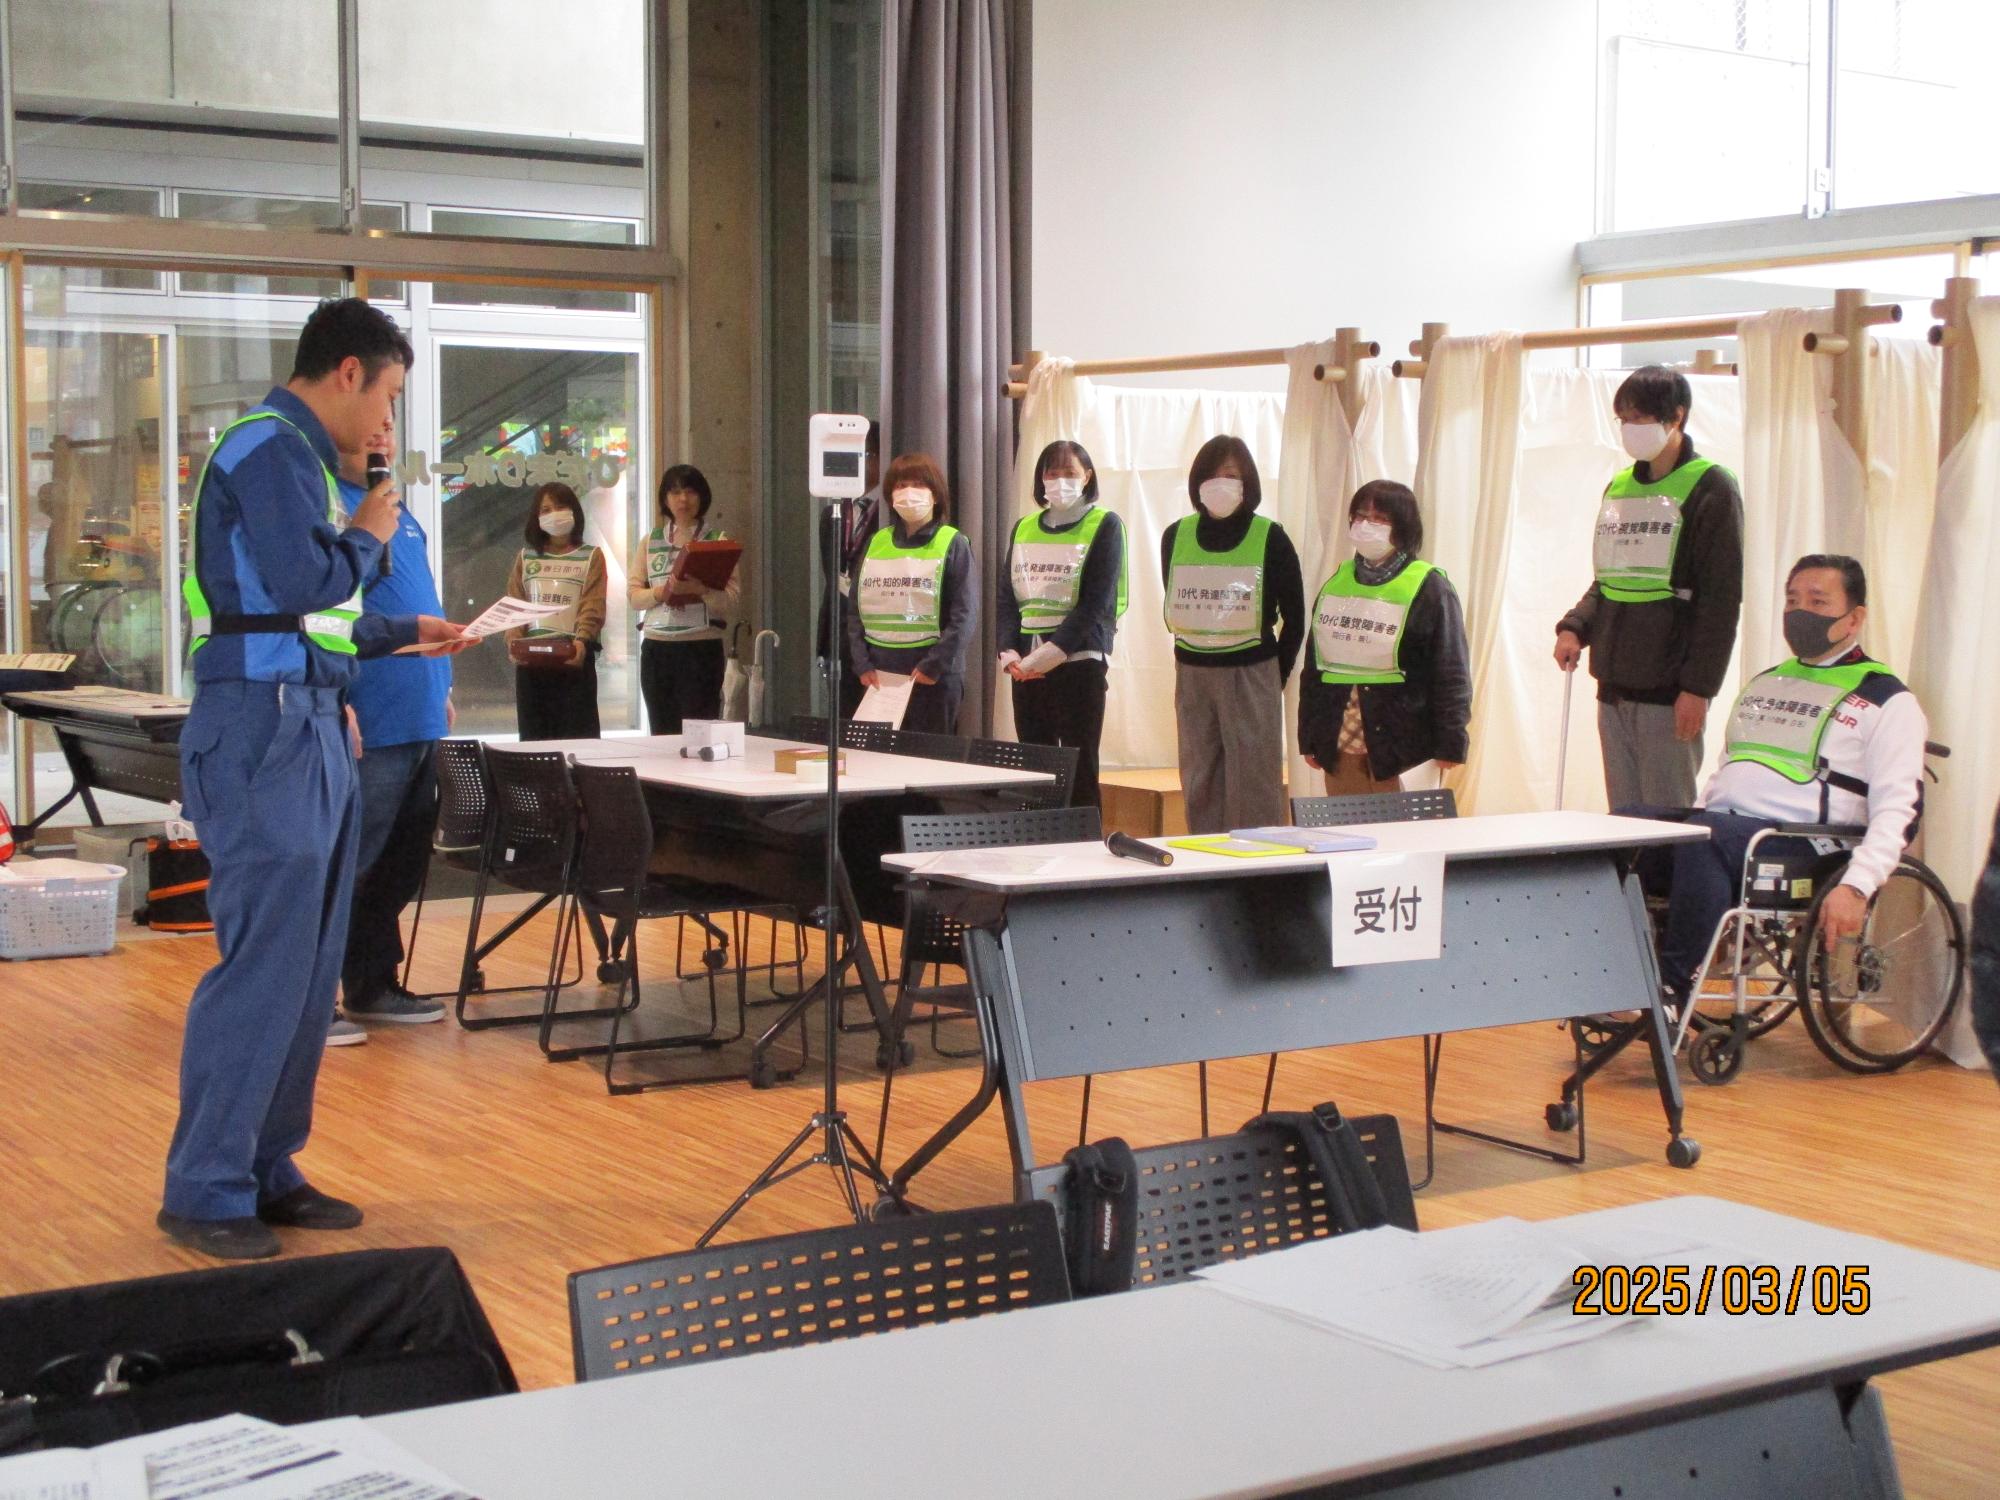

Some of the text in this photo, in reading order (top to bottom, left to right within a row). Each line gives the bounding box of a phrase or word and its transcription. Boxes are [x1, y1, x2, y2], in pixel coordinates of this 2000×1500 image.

[863, 576, 932, 588] 40代 知的障害者
[1177, 587, 1197, 599] 10代
[1318, 613, 1398, 636] 30代 聴覚障害者
[1354, 885, 1422, 935] 受付
[1103, 1201, 1112, 1251] EASTPAK
